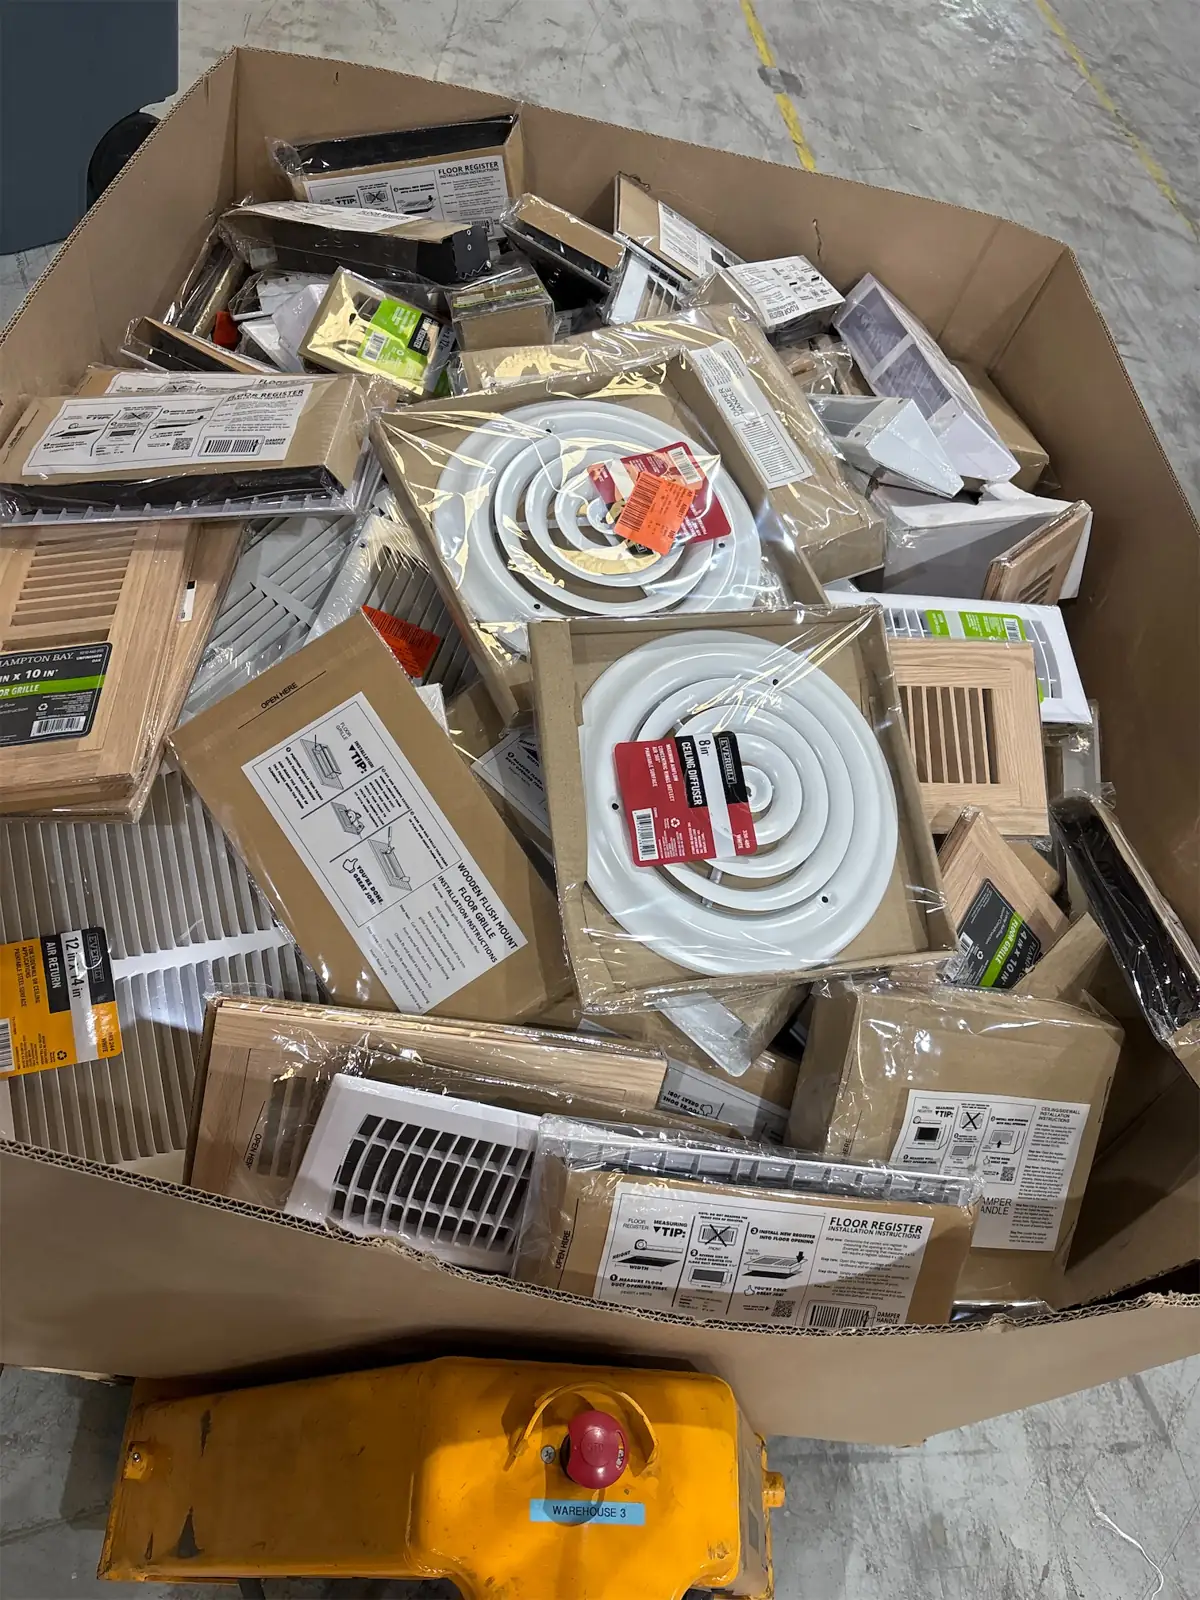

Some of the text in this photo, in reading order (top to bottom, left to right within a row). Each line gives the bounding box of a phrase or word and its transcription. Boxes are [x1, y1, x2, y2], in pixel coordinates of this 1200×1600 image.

[438, 161, 499, 174] FLOOR REGISTER
[260, 389, 304, 398] REGISTER
[724, 385, 745, 415] HANDLE
[717, 386, 740, 418] DAMPER
[52, 652, 74, 661] BAY
[24, 668, 41, 679] 10
[11, 684, 40, 694] GRILLE
[260, 681, 298, 710] OPEN HERE
[335, 724, 347, 740] GRILLE
[339, 721, 352, 737] FLOOR
[698, 738, 710, 746] 8
[354, 740, 374, 768] INSTALLATION
[720, 738, 735, 784] EVERBILT
[349, 751, 369, 774] TIP:
[670, 763, 678, 782] AIRFLOW
[681, 741, 703, 806] CEILING DIFFUSER
[352, 872, 376, 905] GREAT JOB!
[356, 864, 384, 905] YOU'RE DONE.
[456, 861, 518, 950] WOODEN FLUSH MOUNT
[436, 874, 498, 963] INSTALLATION INSTRUCTIONS
[457, 886, 496, 940] FLOOR GRILLE
[1007, 919, 1018, 943] FLOOR
[1020, 930, 1028, 940] 4
[63, 936, 79, 950] 12
[1017, 938, 1025, 949] IN
[66, 951, 79, 960] in
[994, 941, 1011, 964] GRILLE
[13, 948, 22, 972] PAINTABLE
[28, 955, 37, 977] SIDEWALL
[45, 941, 62, 988] AIR RETURN
[1006, 958, 1018, 972] 10
[16, 972, 24, 986] STEEL
[69, 973, 82, 986] 14
[32, 985, 40, 1003] CEILING
[100, 1038, 108, 1052] WHITE
[666, 1090, 700, 1107] GREAT JOB!
[939, 1110, 953, 1118] TIP:
[1038, 1115, 1069, 1123] INSTRUCTIONS
[1039, 1110, 1069, 1118] INSTALLATION
[252, 1132, 262, 1151] OPEN
[981, 1197, 1012, 1207] AMPER
[981, 1206, 1009, 1216] ANDLE
[622, 1222, 649, 1231] REGISTER
[627, 1217, 646, 1225] FLOOR
[653, 1218, 687, 1228] MEASURING
[829, 1215, 923, 1236] FLOOR REGISTER
[660, 1226, 686, 1239] TIP:
[827, 1223, 921, 1241] INSTALLATION INSTRUCTIONS
[790, 1237, 814, 1245] OPENING
[554, 1249, 567, 1269] OPEN
[612, 1248, 631, 1261] HEIGHT
[618, 1275, 644, 1284] MEASURE
[626, 1282, 651, 1291] OPENING
[877, 1310, 900, 1319] DAMPER
[553, 1505, 626, 1518] WAREHOUSE 3
